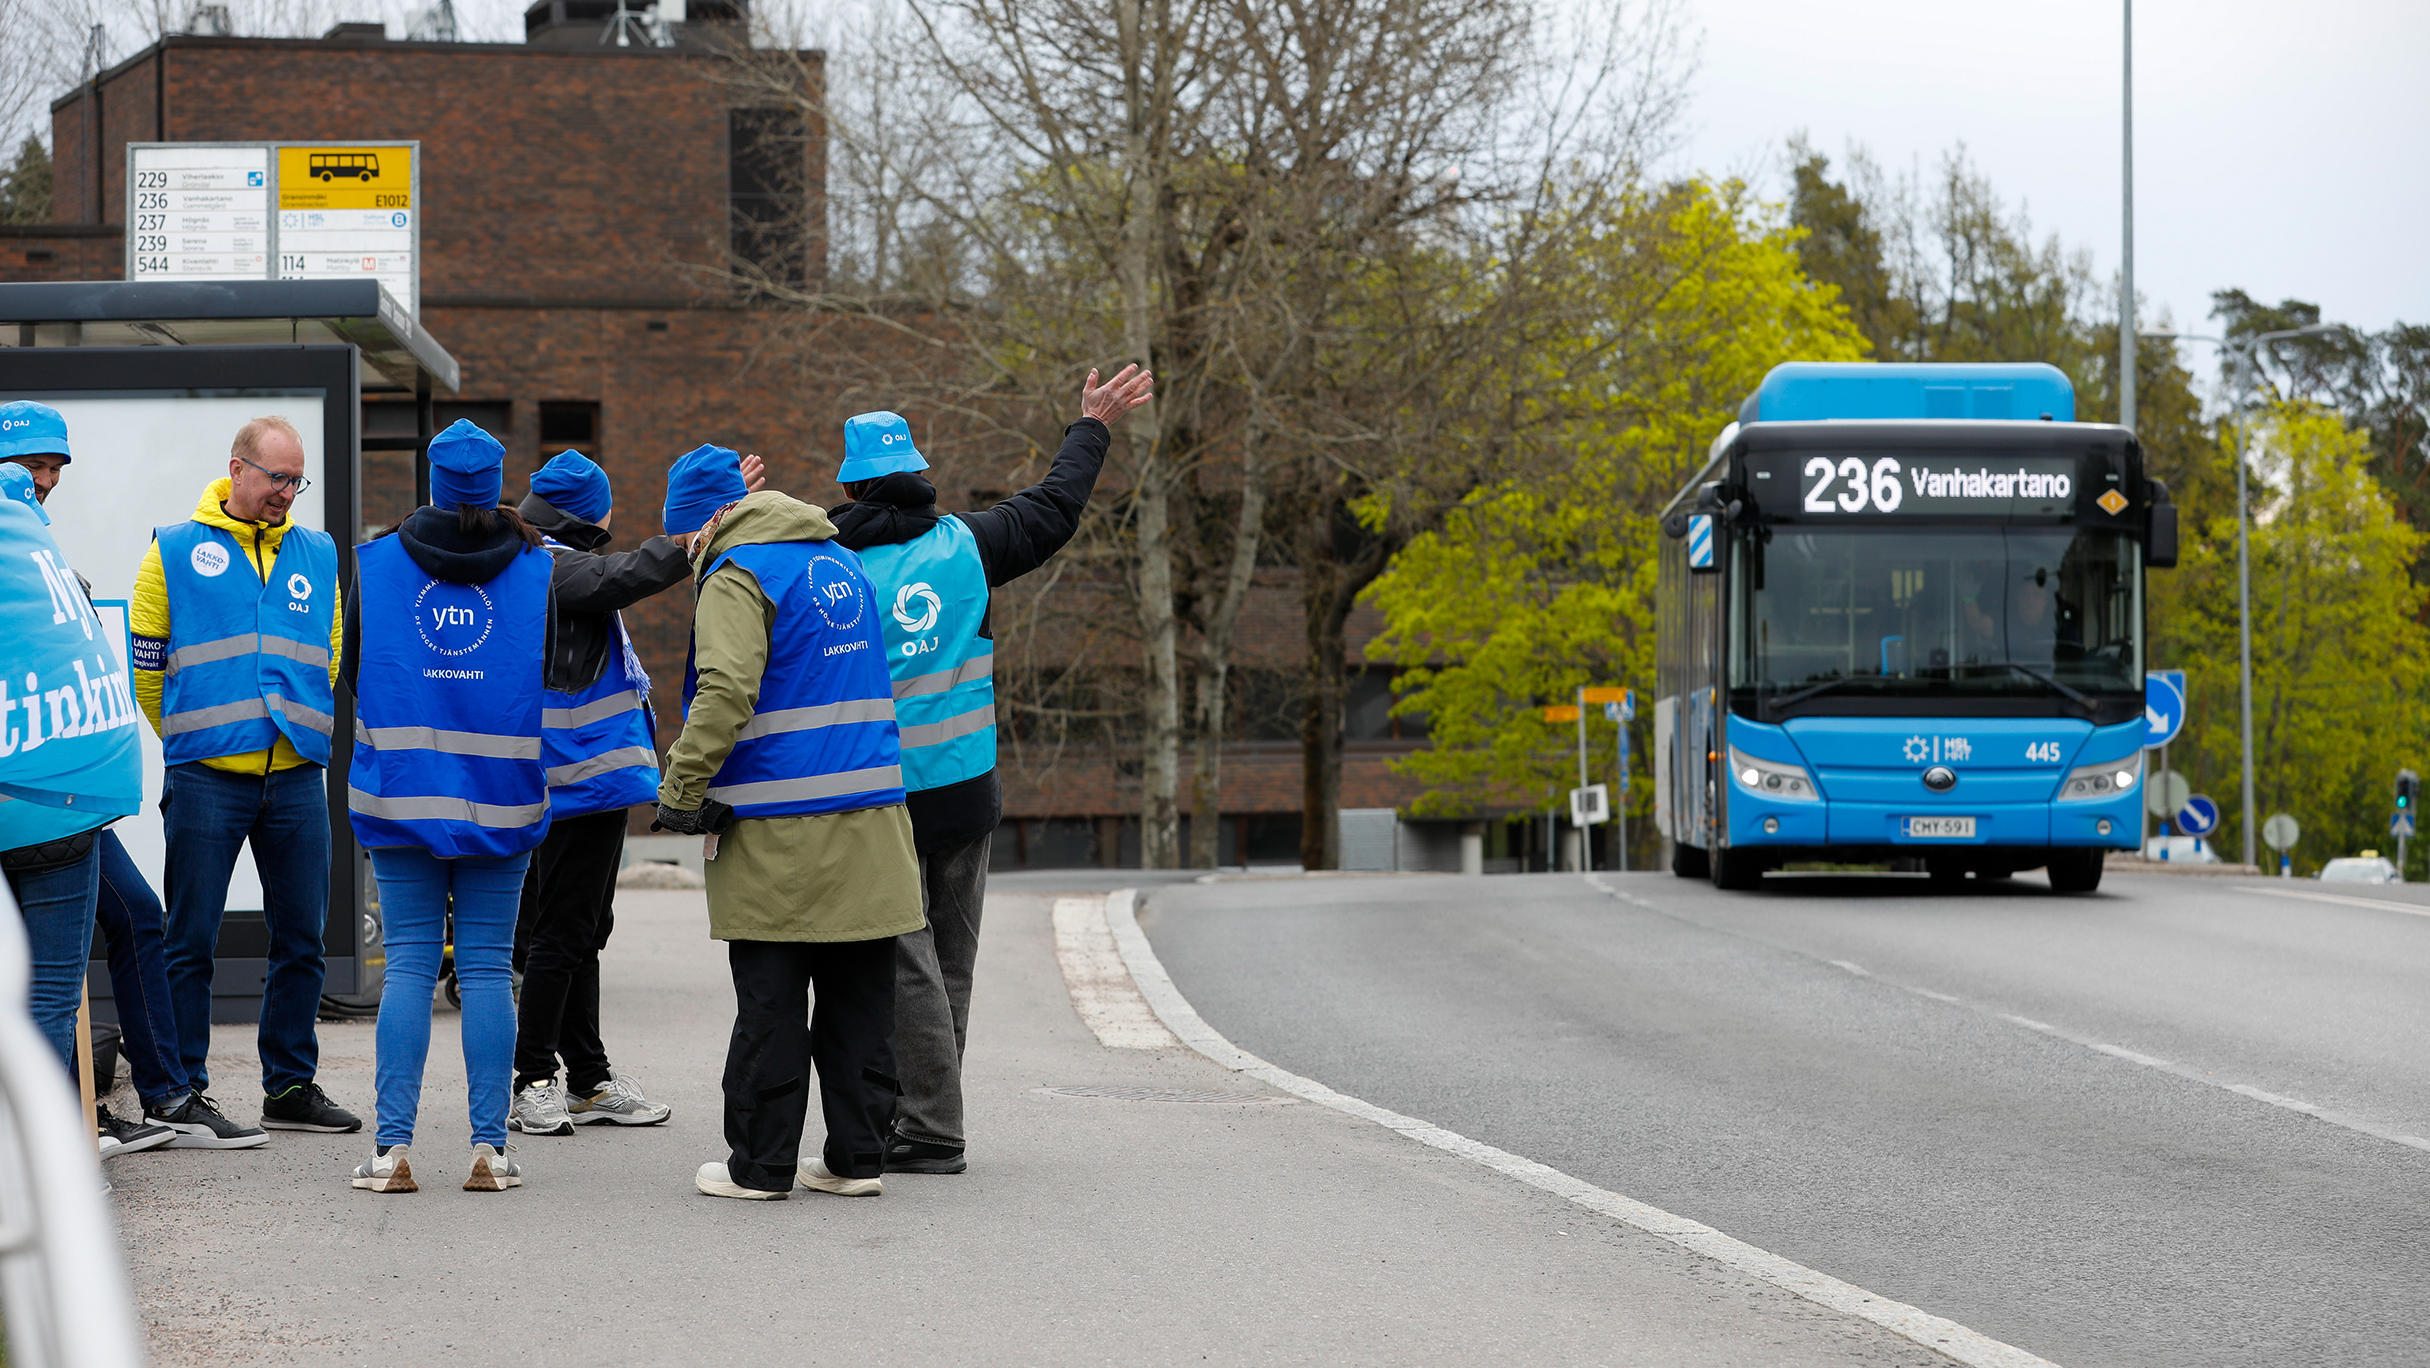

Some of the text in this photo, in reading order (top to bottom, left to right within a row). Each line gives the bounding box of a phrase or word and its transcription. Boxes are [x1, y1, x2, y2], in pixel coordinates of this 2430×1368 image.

[138, 172, 168, 188] 229
[139, 193, 168, 209] 236
[375, 194, 408, 207] E1012
[138, 214, 166, 231] 237
[138, 235, 167, 251] 239
[139, 256, 169, 272] 544
[282, 255, 305, 271] 114
[1804, 457, 2070, 513] 236 Vanhakartano
[196, 548, 226, 564] LAKKO-
[196, 555, 220, 570] VAHTI
[415, 579, 440, 608] YLEMMÄT
[821, 581, 854, 607] ytn
[288, 601, 310, 614] OAJ
[415, 615, 421, 626] DE
[432, 605, 474, 631] ytn
[133, 637, 165, 651] LAKKO-
[901, 636, 939, 657] OAJ
[134, 647, 160, 660] VAHTI
[422, 667, 484, 680] LAKKOVAHTI
[1944, 737, 1970, 750] HSL
[2025, 741, 2061, 762] 445
[1912, 819, 1970, 834] CMY-591
